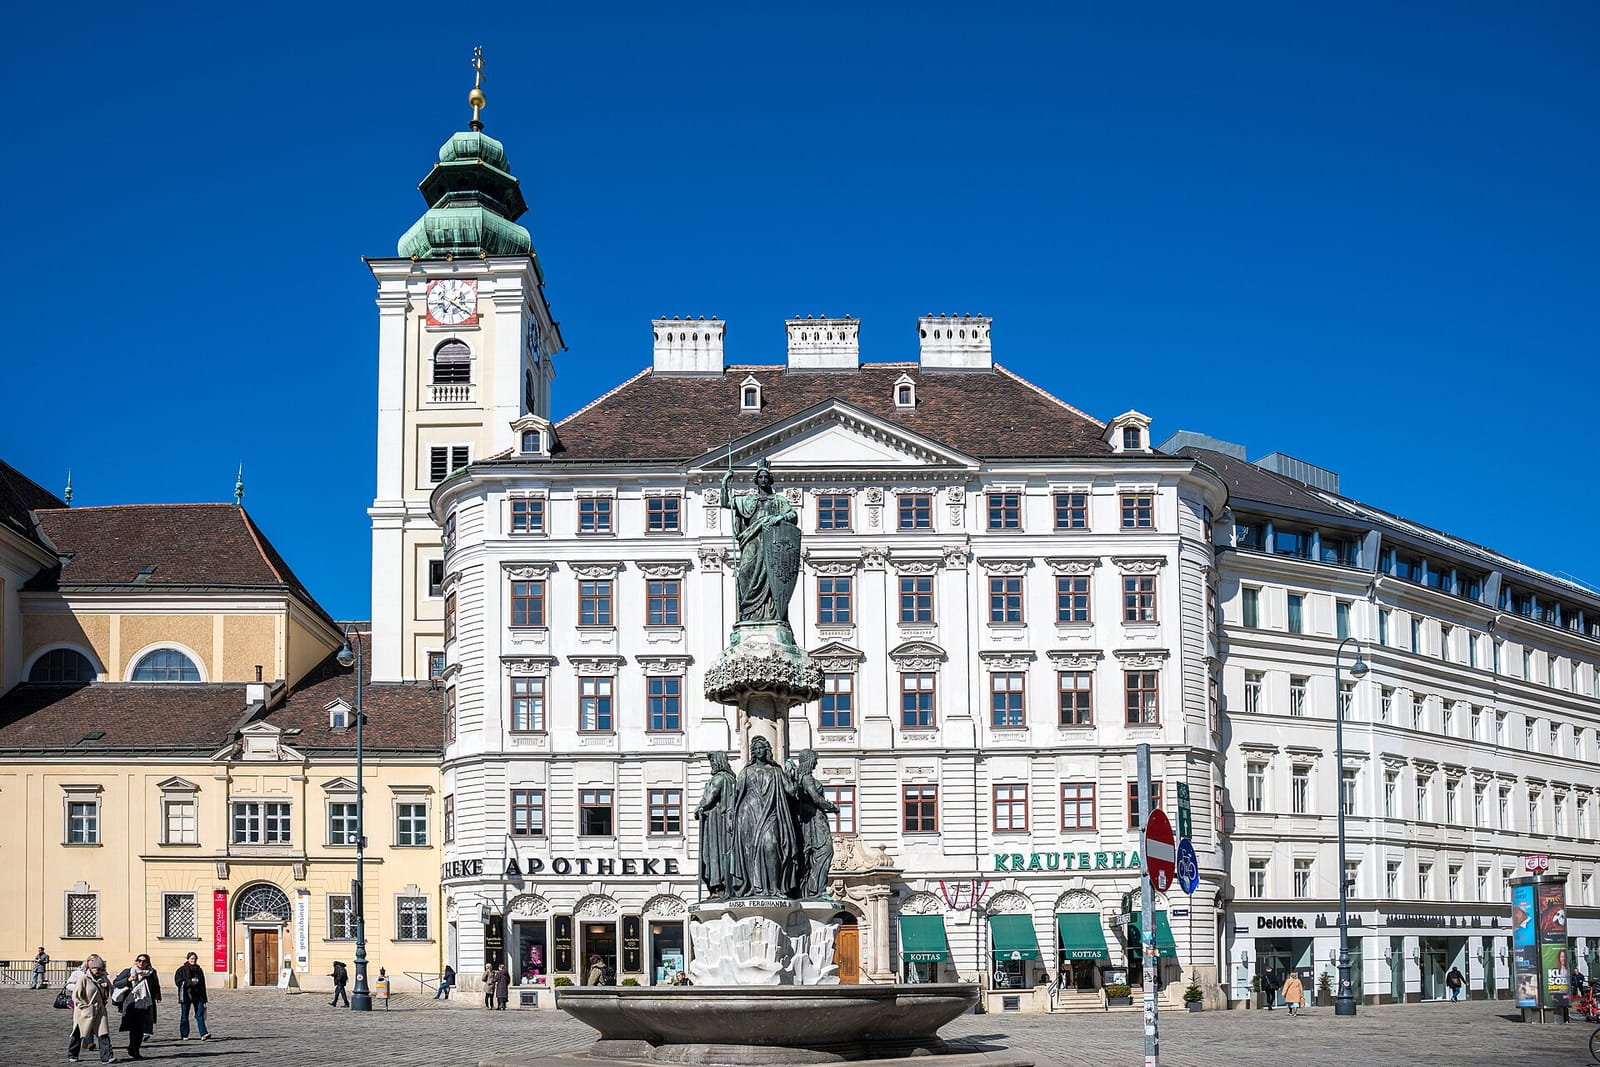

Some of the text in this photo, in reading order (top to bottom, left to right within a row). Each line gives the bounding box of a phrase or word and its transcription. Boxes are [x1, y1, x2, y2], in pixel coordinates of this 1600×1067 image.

[442, 858, 484, 879] HEKE
[505, 857, 680, 875] APOTHEKE
[994, 850, 1141, 871] KRÄUTERHA
[910, 953, 941, 961] KOTTAS
